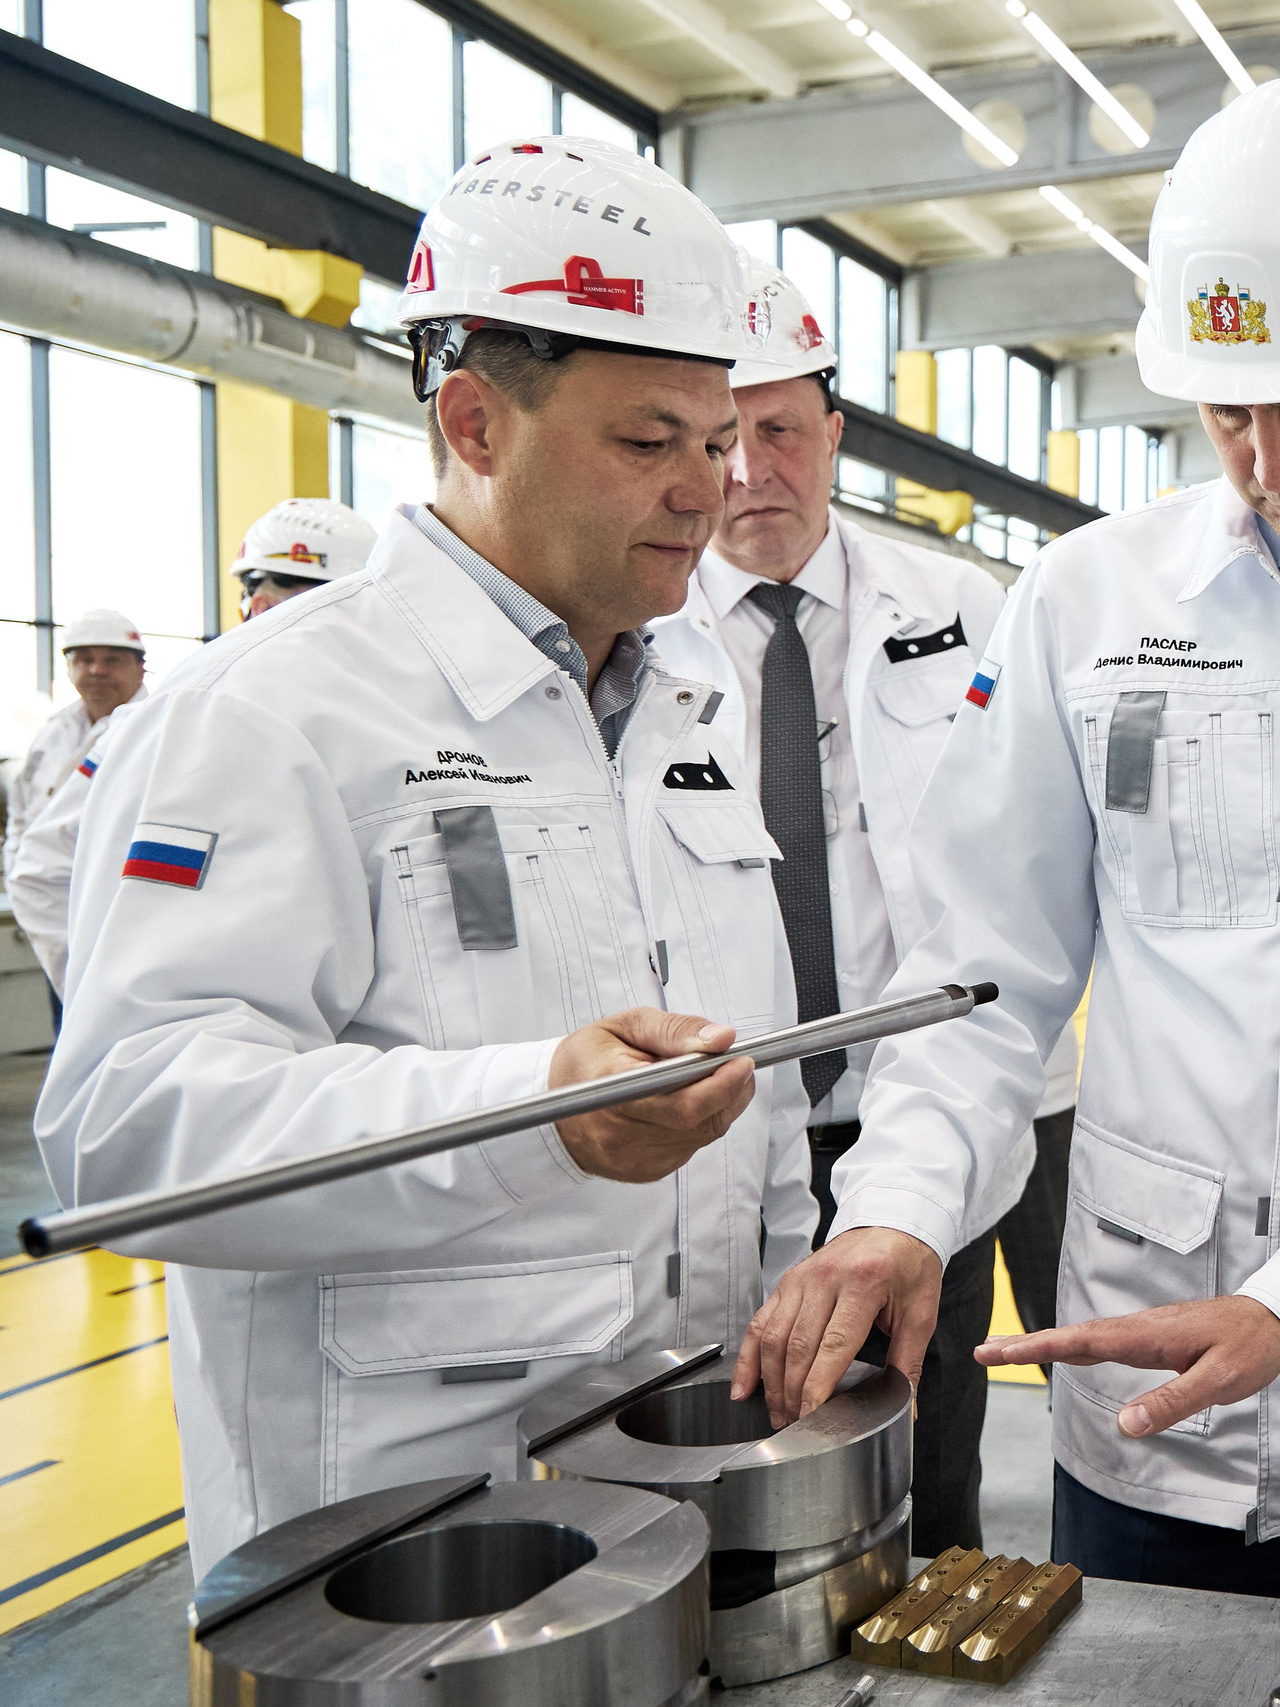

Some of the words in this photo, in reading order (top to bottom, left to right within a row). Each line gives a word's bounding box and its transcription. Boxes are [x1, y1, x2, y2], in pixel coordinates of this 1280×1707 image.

[449, 179, 651, 236] YBERSTEEL
[1140, 637, 1197, 652] ПАСЛЕР
[1094, 654, 1134, 670] Денис
[1137, 653, 1243, 671] Владимирович
[405, 768, 469, 785] Алексей
[468, 769, 533, 785] Иванович
